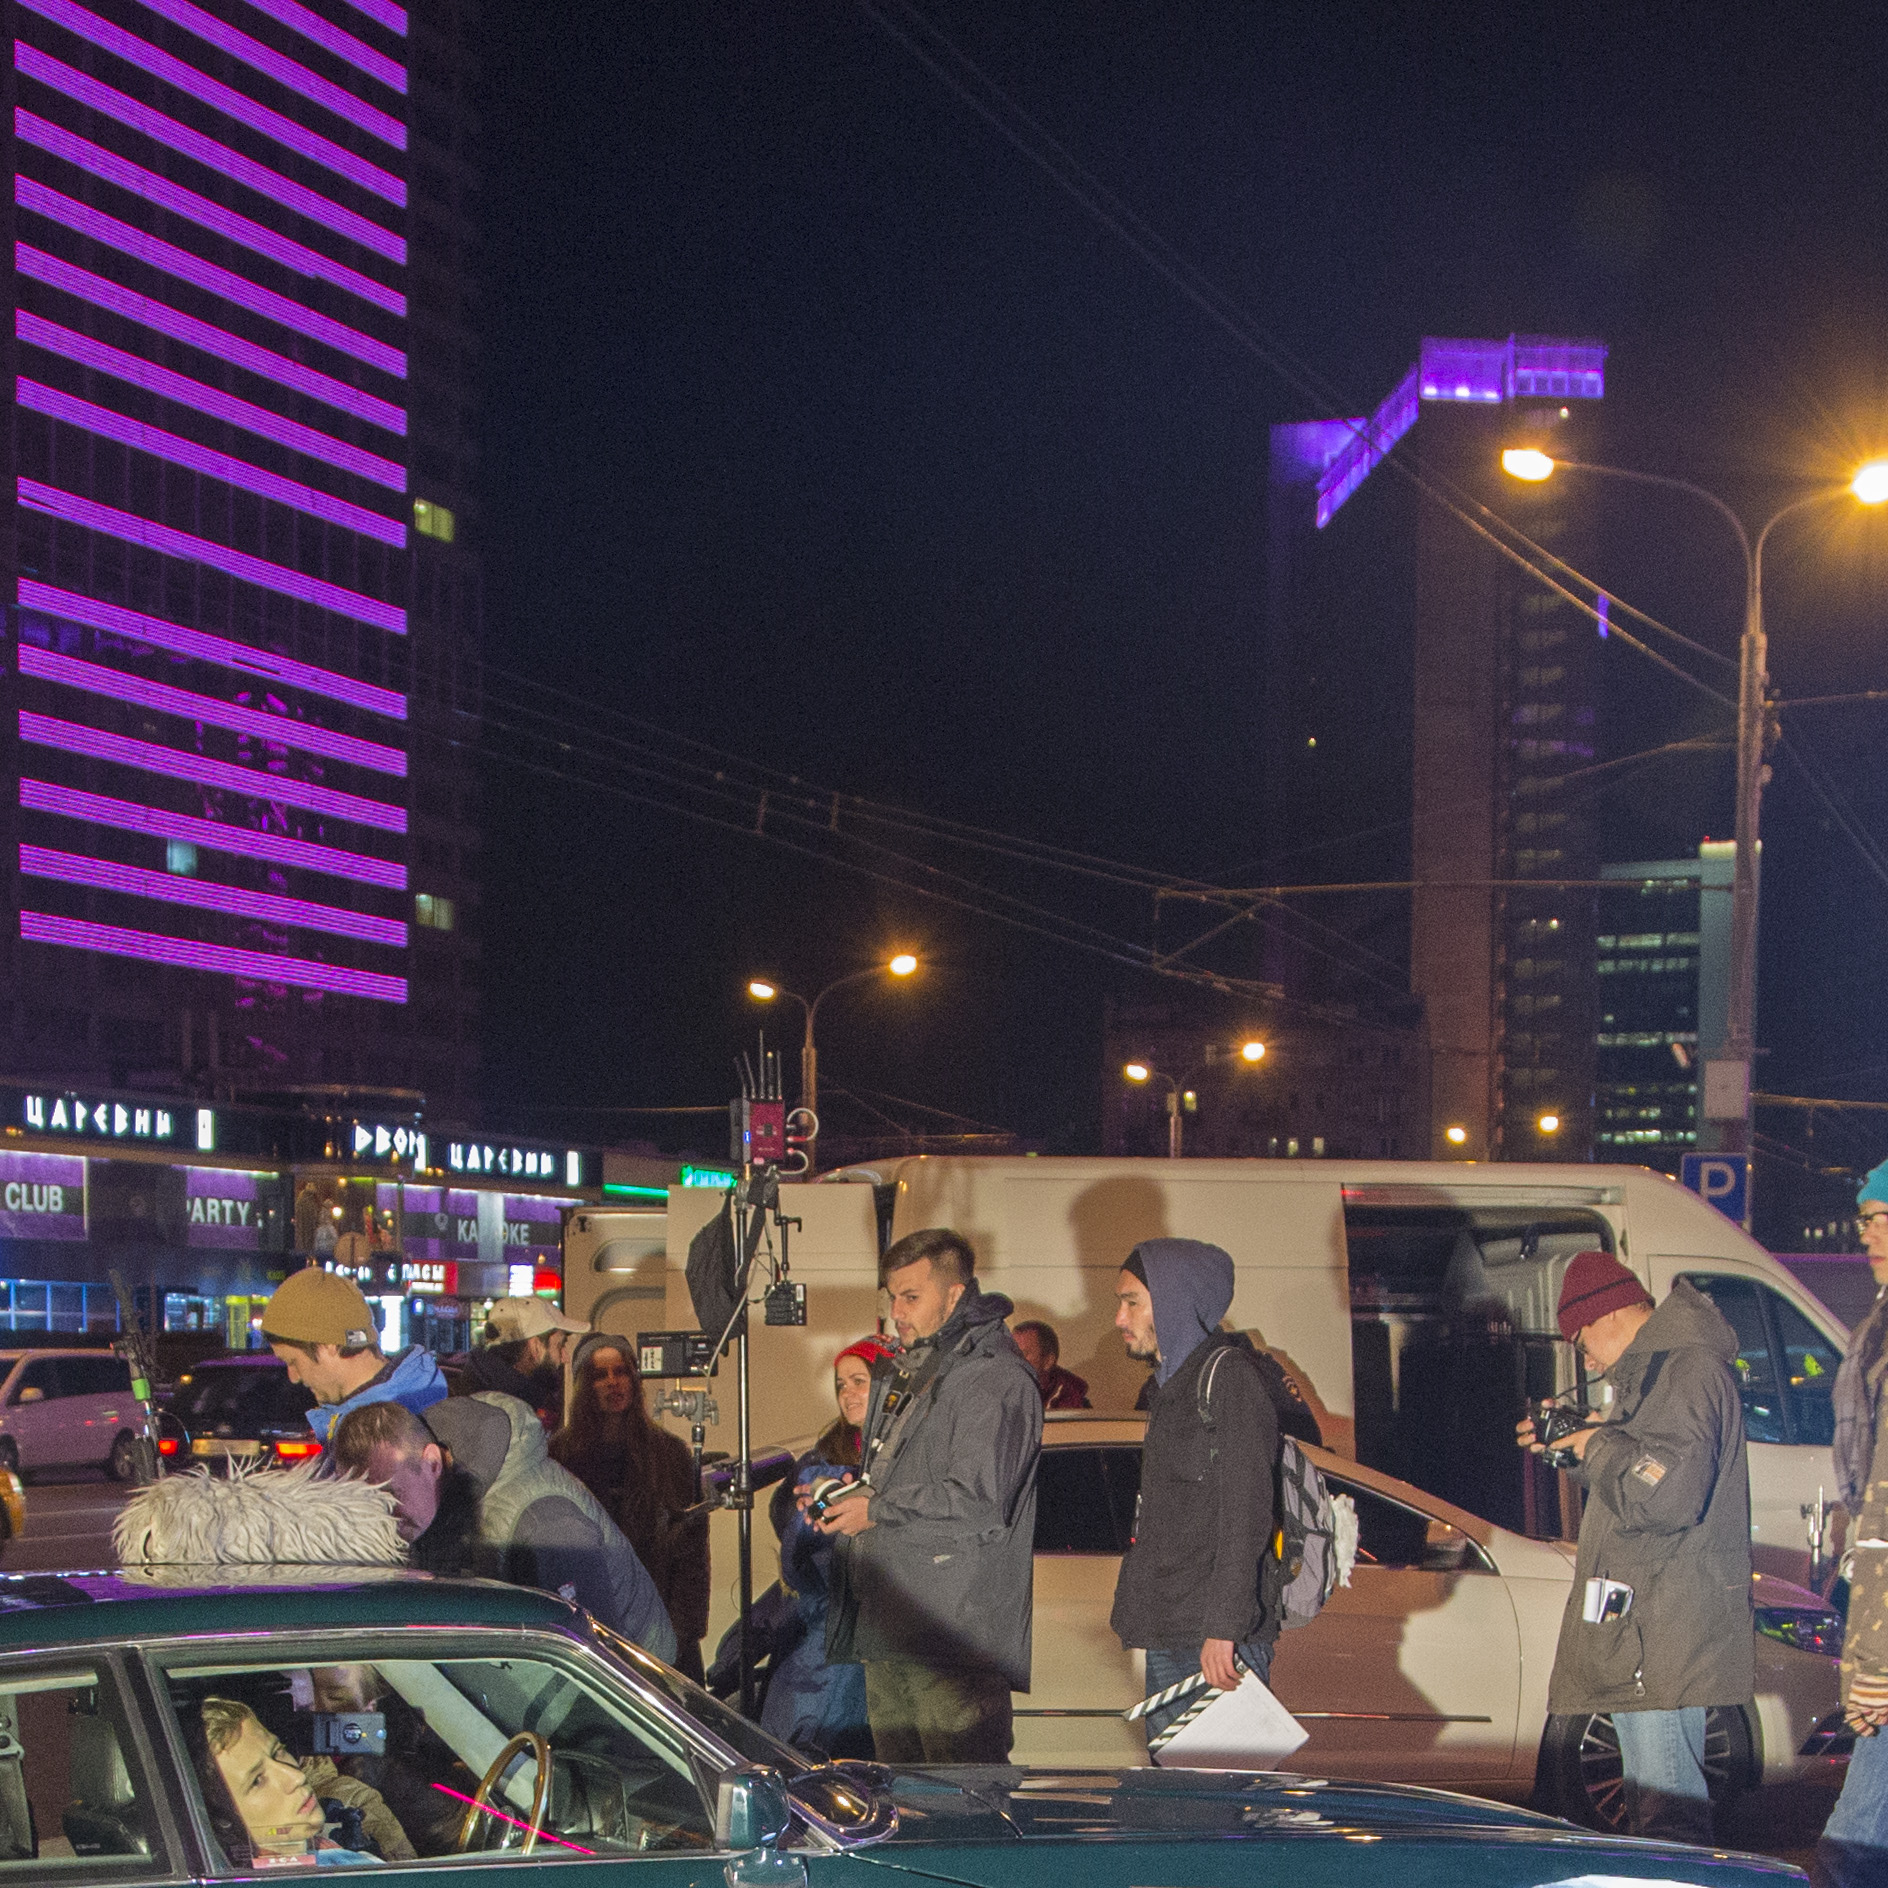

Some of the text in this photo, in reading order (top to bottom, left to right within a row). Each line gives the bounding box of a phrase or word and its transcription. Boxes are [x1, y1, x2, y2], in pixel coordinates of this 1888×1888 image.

[5, 1181, 64, 1212] CLUB
[186, 1197, 252, 1226] ARTY
[457, 1218, 530, 1247] KAKE
